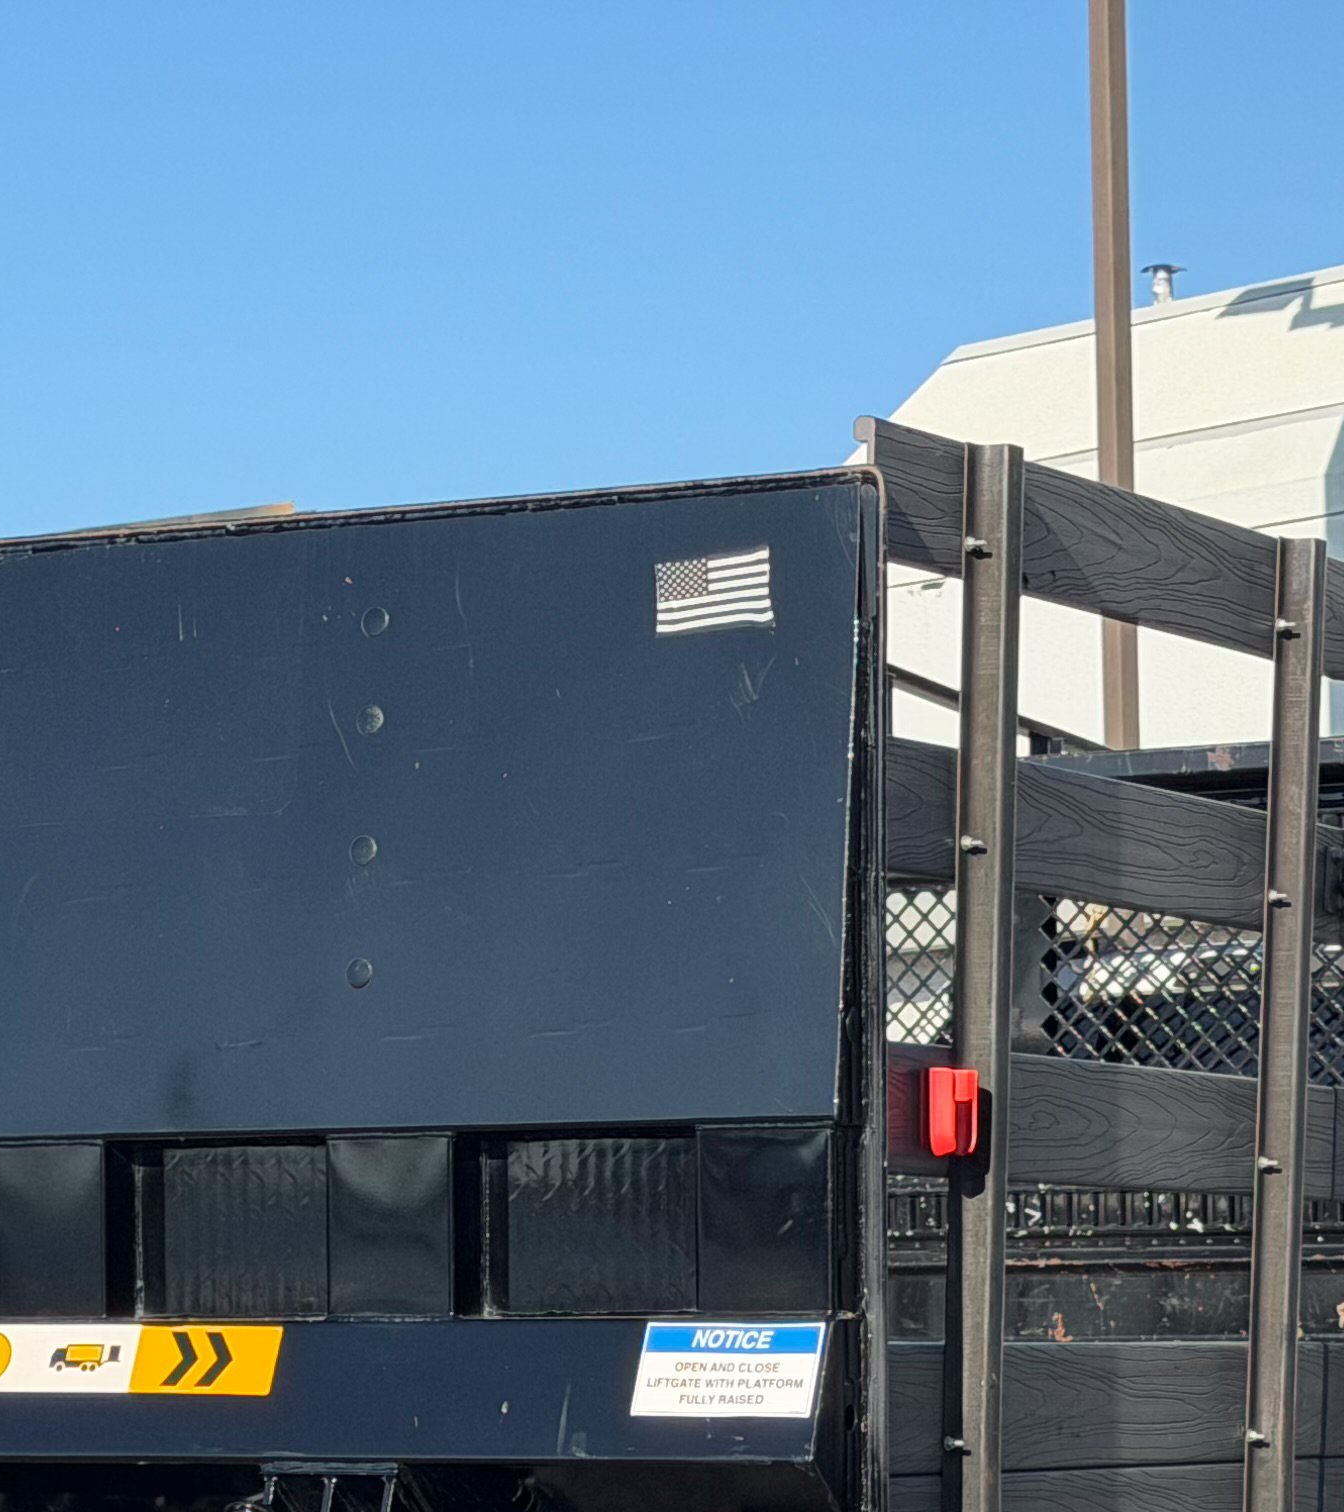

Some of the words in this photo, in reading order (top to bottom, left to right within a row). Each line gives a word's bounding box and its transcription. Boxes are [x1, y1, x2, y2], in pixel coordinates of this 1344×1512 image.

[691, 1329, 775, 1350] NOTICE
[674, 1361, 708, 1373] OPEN
[709, 1362, 735, 1373] AND
[738, 1362, 781, 1374] CLOSE
[646, 1377, 701, 1389] LIFTGATE
[704, 1378, 734, 1389] WITH
[737, 1378, 804, 1390] PLATFORM
[678, 1394, 716, 1405] FULLY
[718, 1394, 764, 1405] RAISED
